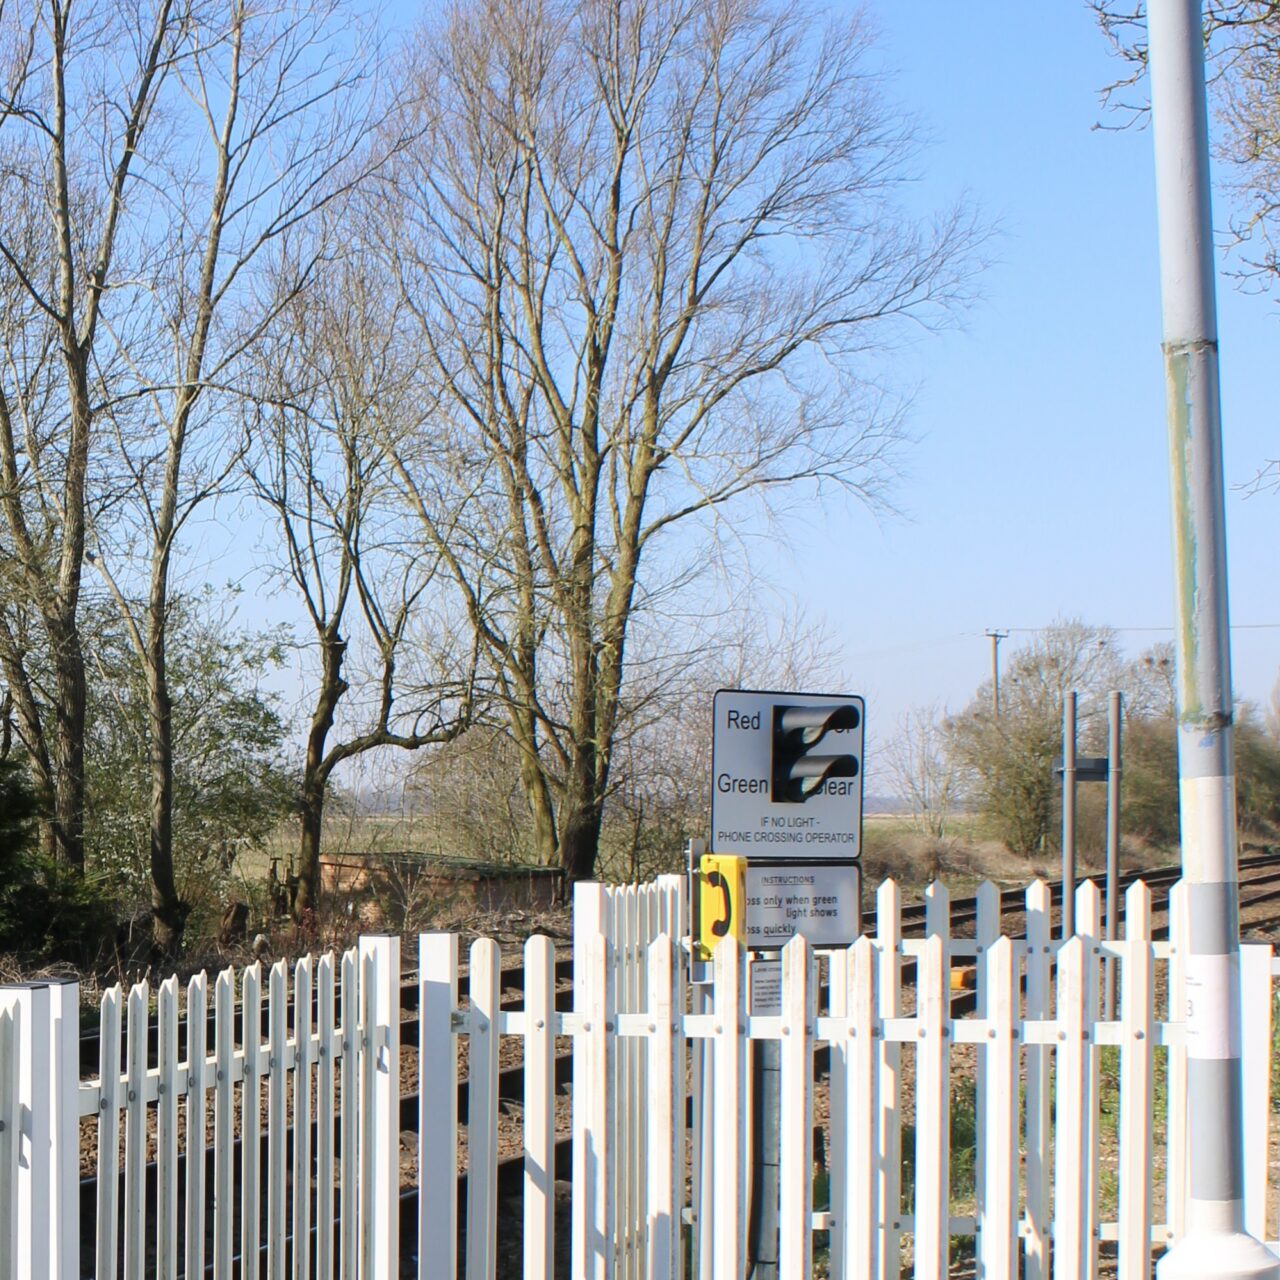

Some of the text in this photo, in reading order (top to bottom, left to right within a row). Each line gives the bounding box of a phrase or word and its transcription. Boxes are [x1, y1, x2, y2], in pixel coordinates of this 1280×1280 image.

[727, 710, 760, 730] Red
[718, 773, 768, 793] Green
[761, 816, 769, 827] IF
[772, 817, 785, 827] NO
[788, 817, 814, 827] LIGHT
[718, 831, 854, 843] PHONE CROSSING OPERATOR
[761, 876, 815, 884] INSTRUCTIONS
[763, 895, 782, 907] only
[786, 895, 809, 905] when
[812, 896, 837, 906] green
[786, 908, 837, 919] light shows
[763, 924, 796, 936] quickly
